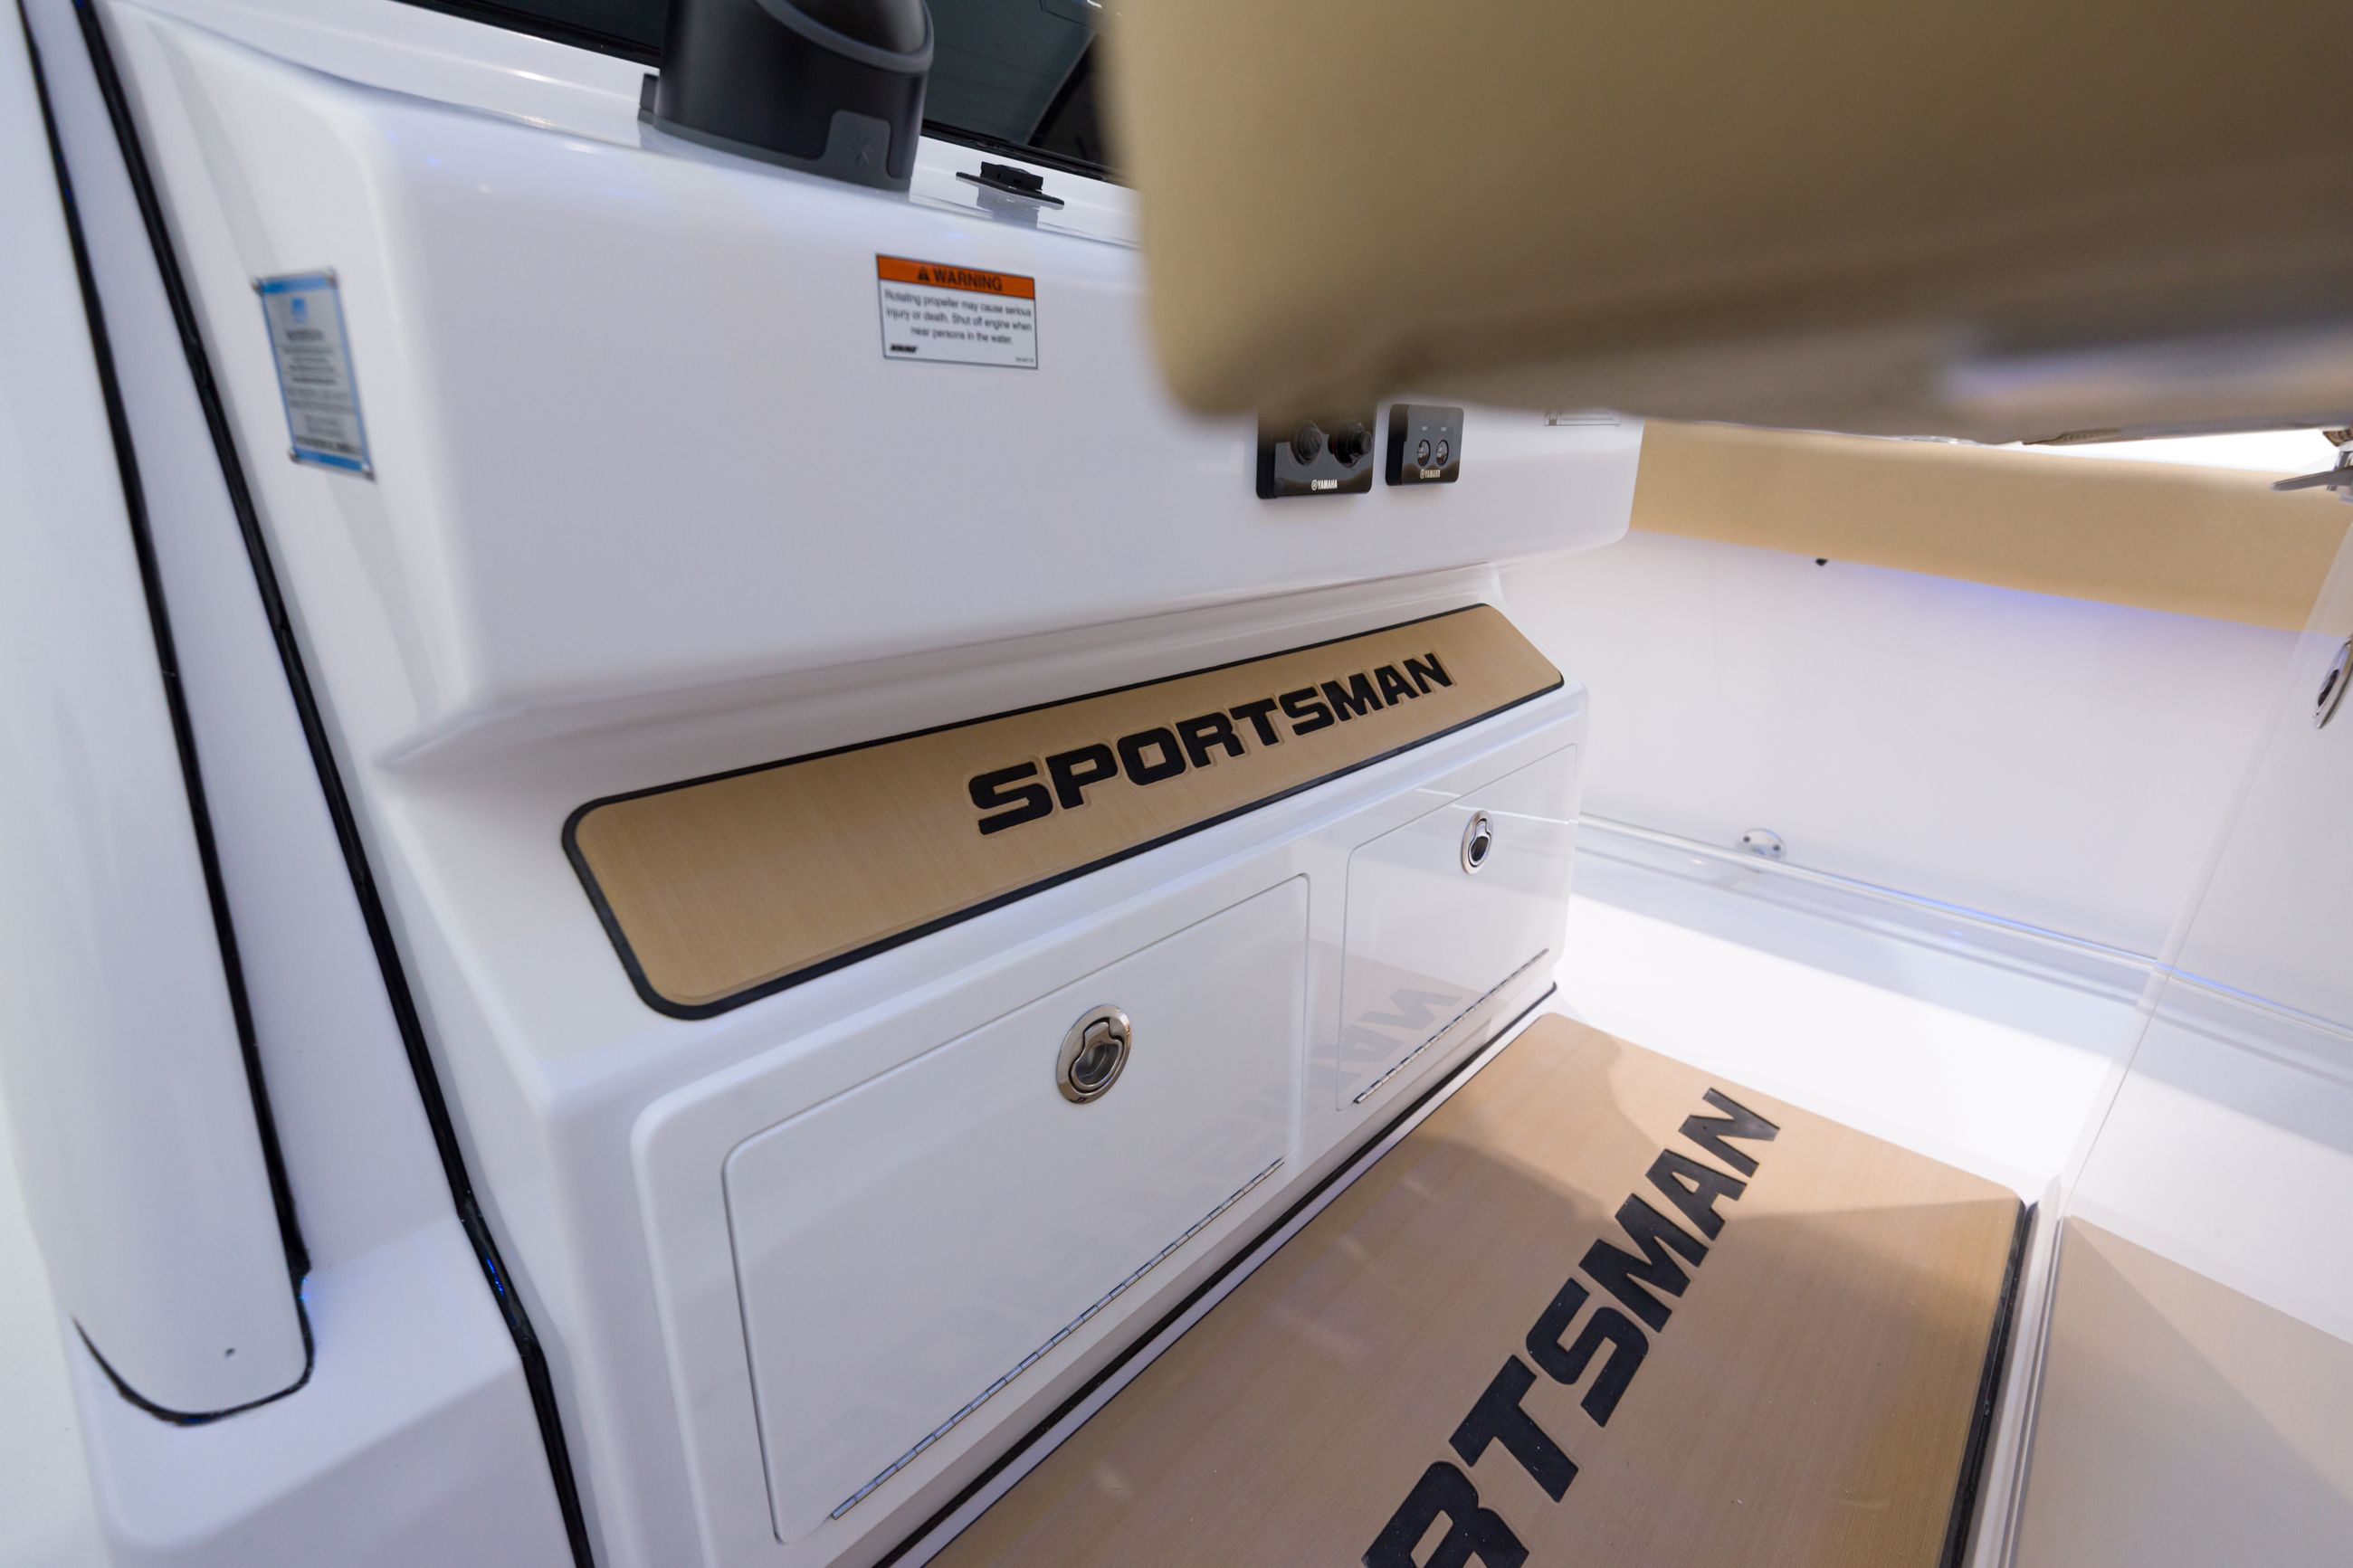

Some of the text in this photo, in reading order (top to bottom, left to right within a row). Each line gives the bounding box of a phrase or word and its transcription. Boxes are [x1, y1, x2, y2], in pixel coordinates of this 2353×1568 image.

[933, 269, 1003, 292] WARNING
[884, 289, 1032, 317] Rotating propeller may cause serious
[912, 310, 921, 319] or
[952, 313, 971, 326] Shut
[973, 317, 983, 327] off
[984, 318, 1010, 330] engine
[1012, 320, 1032, 331] when
[910, 327, 930, 337] near
[932, 328, 965, 339] persons
[967, 328, 976, 340] in
[976, 330, 988, 341] the
[1318, 479, 1338, 489] YAMAHA
[967, 652, 1453, 835] SPORTSMAN
